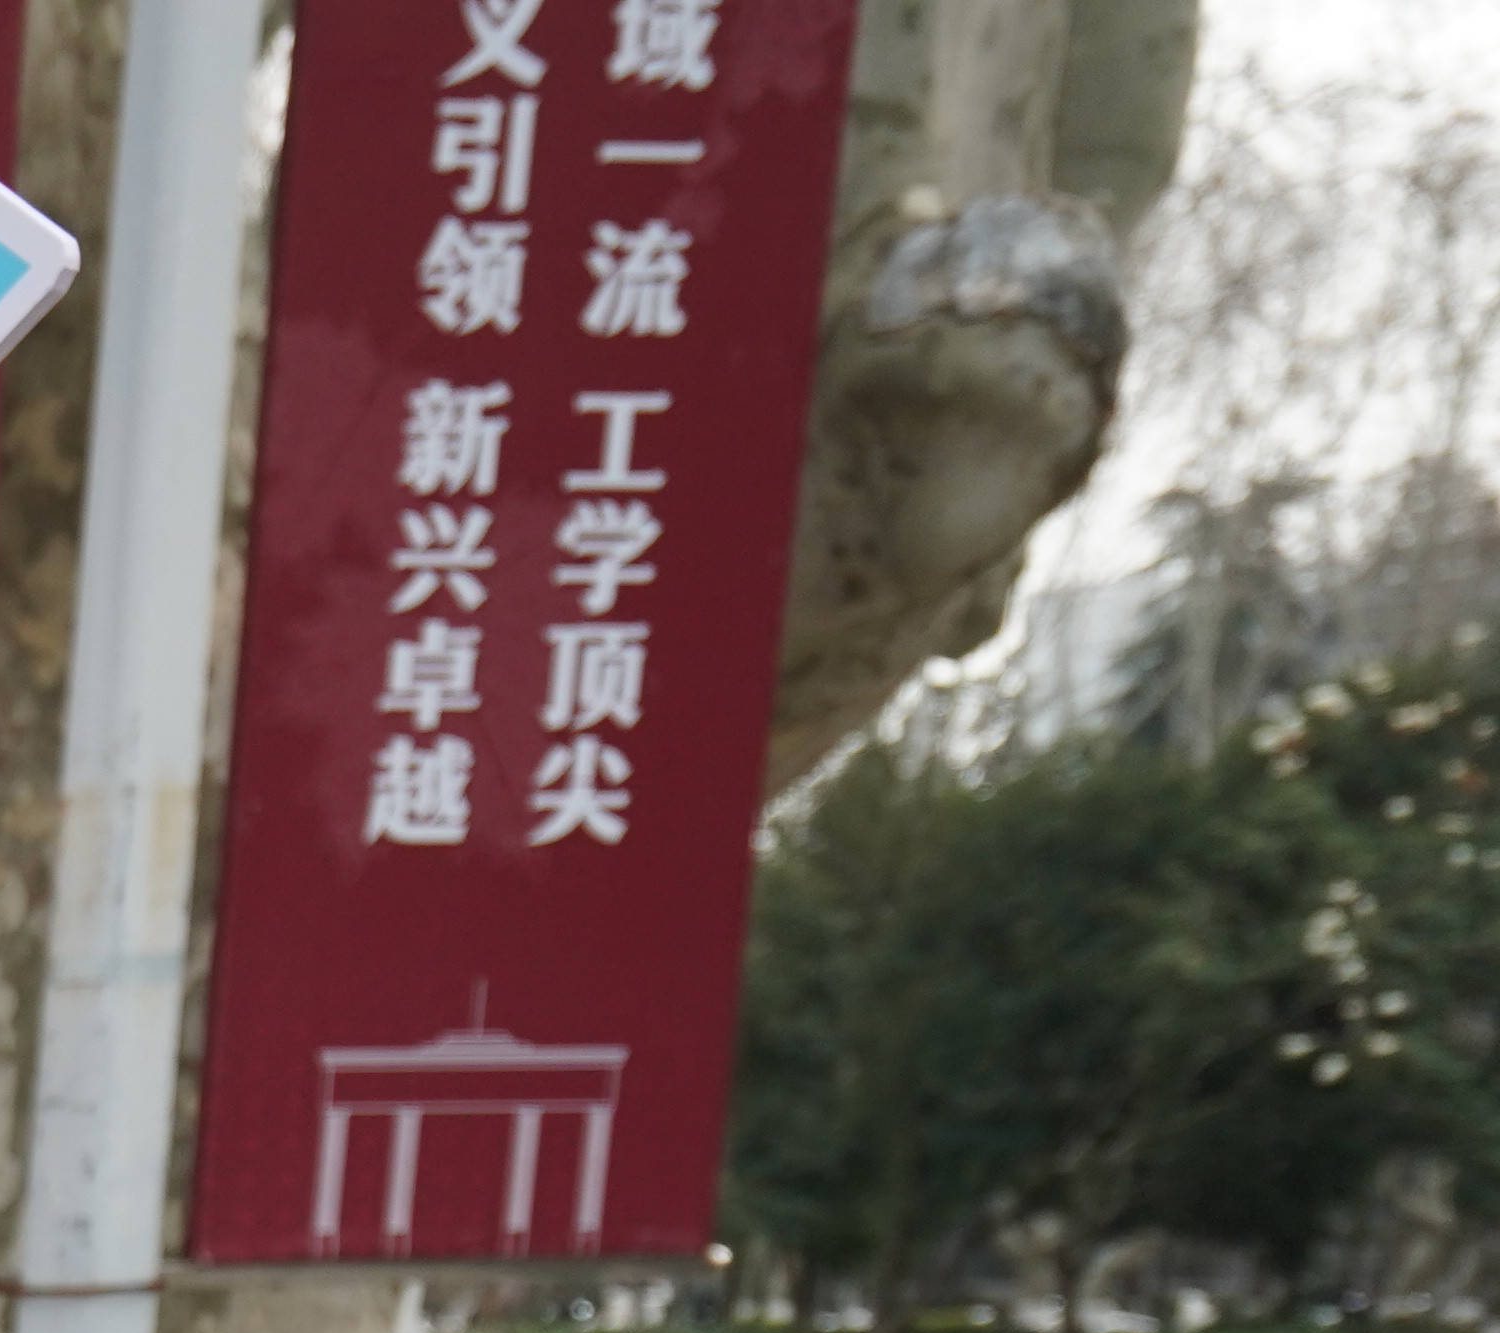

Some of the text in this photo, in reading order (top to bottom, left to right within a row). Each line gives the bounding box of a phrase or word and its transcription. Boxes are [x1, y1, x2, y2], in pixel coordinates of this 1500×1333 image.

[364, 381, 511, 845] 新兴卓越
[527, 390, 674, 845] 工学顶尖
